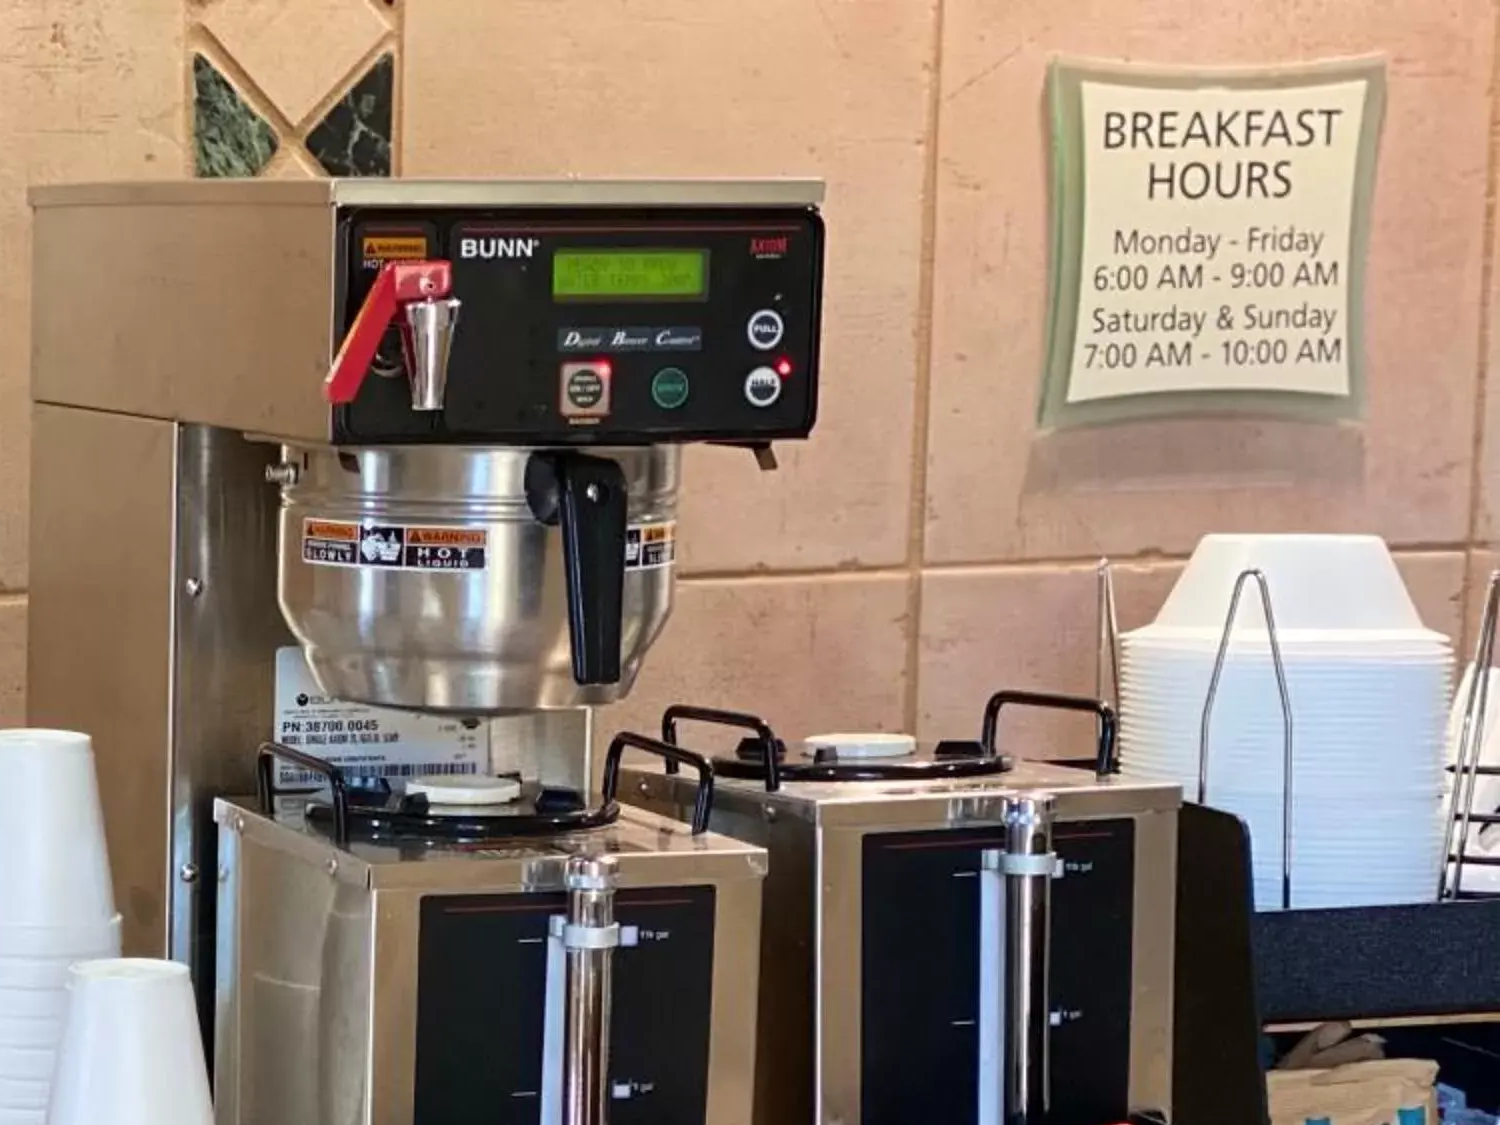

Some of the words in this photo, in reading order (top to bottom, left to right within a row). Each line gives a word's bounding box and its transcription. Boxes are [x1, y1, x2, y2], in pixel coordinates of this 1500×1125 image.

[1102, 110, 1343, 149] BREAKFAST
[1147, 161, 1293, 200] HOURS
[460, 238, 534, 259] BUNN
[1113, 227, 1221, 260] Monday
[1247, 224, 1324, 258] Friday
[362, 259, 384, 269] HOT
[1093, 265, 1148, 292] 6:00
[1156, 265, 1203, 289] AM
[1230, 262, 1285, 289] 9:00
[1292, 262, 1339, 287] AM
[1092, 304, 1207, 338] Saturday
[1216, 305, 1234, 331] &
[1243, 302, 1338, 334] Sunday
[1084, 343, 1137, 369] 7:00
[1144, 342, 1192, 368] AM
[1222, 340, 1287, 366] 10:00
[1295, 338, 1342, 364] AM
[417, 547, 469, 559] HOT
